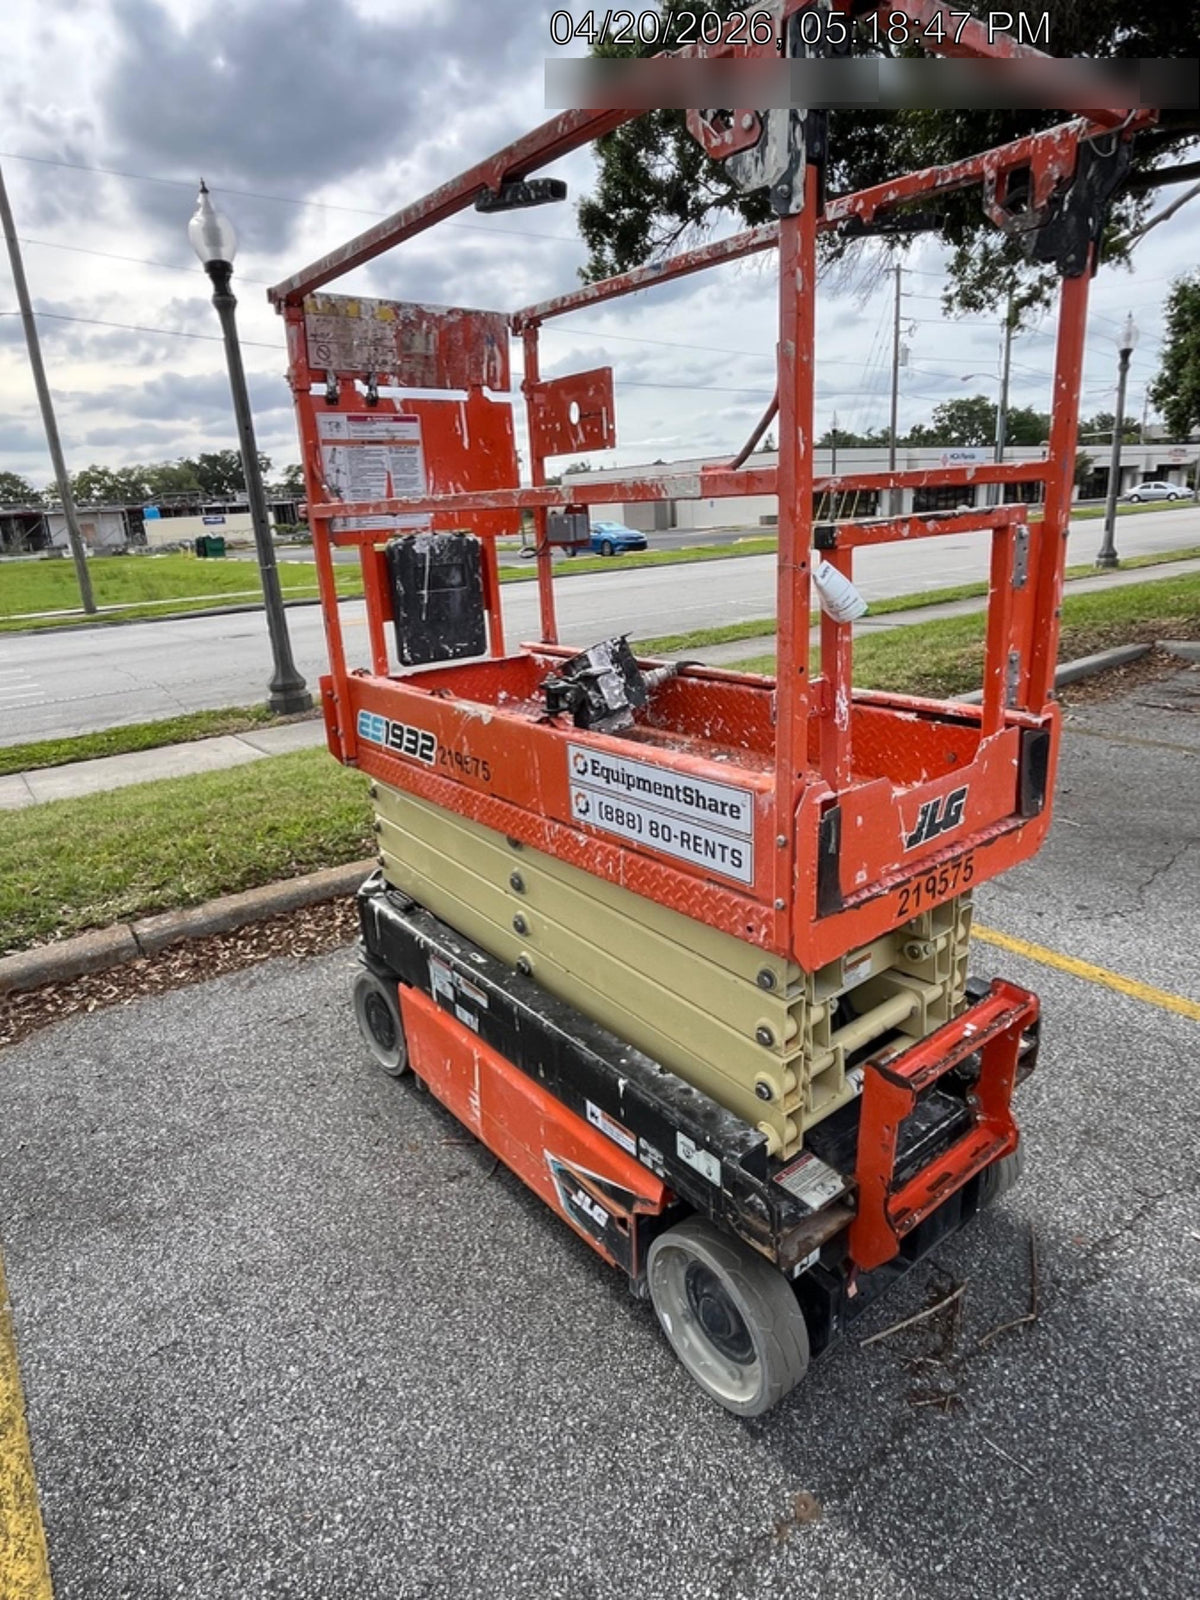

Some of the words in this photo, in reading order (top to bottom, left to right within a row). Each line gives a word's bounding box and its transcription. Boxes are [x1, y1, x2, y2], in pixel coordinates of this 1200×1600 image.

[359, 710, 436, 763] ES1932
[438, 744, 491, 782] 219575
[590, 758, 741, 820] EquipmentShare
[905, 785, 969, 852] JLG
[599, 801, 643, 834] (888)
[649, 820, 742, 869] 80-RENTS
[897, 856, 974, 918] 219575
[571, 1188, 609, 1228] JLG
